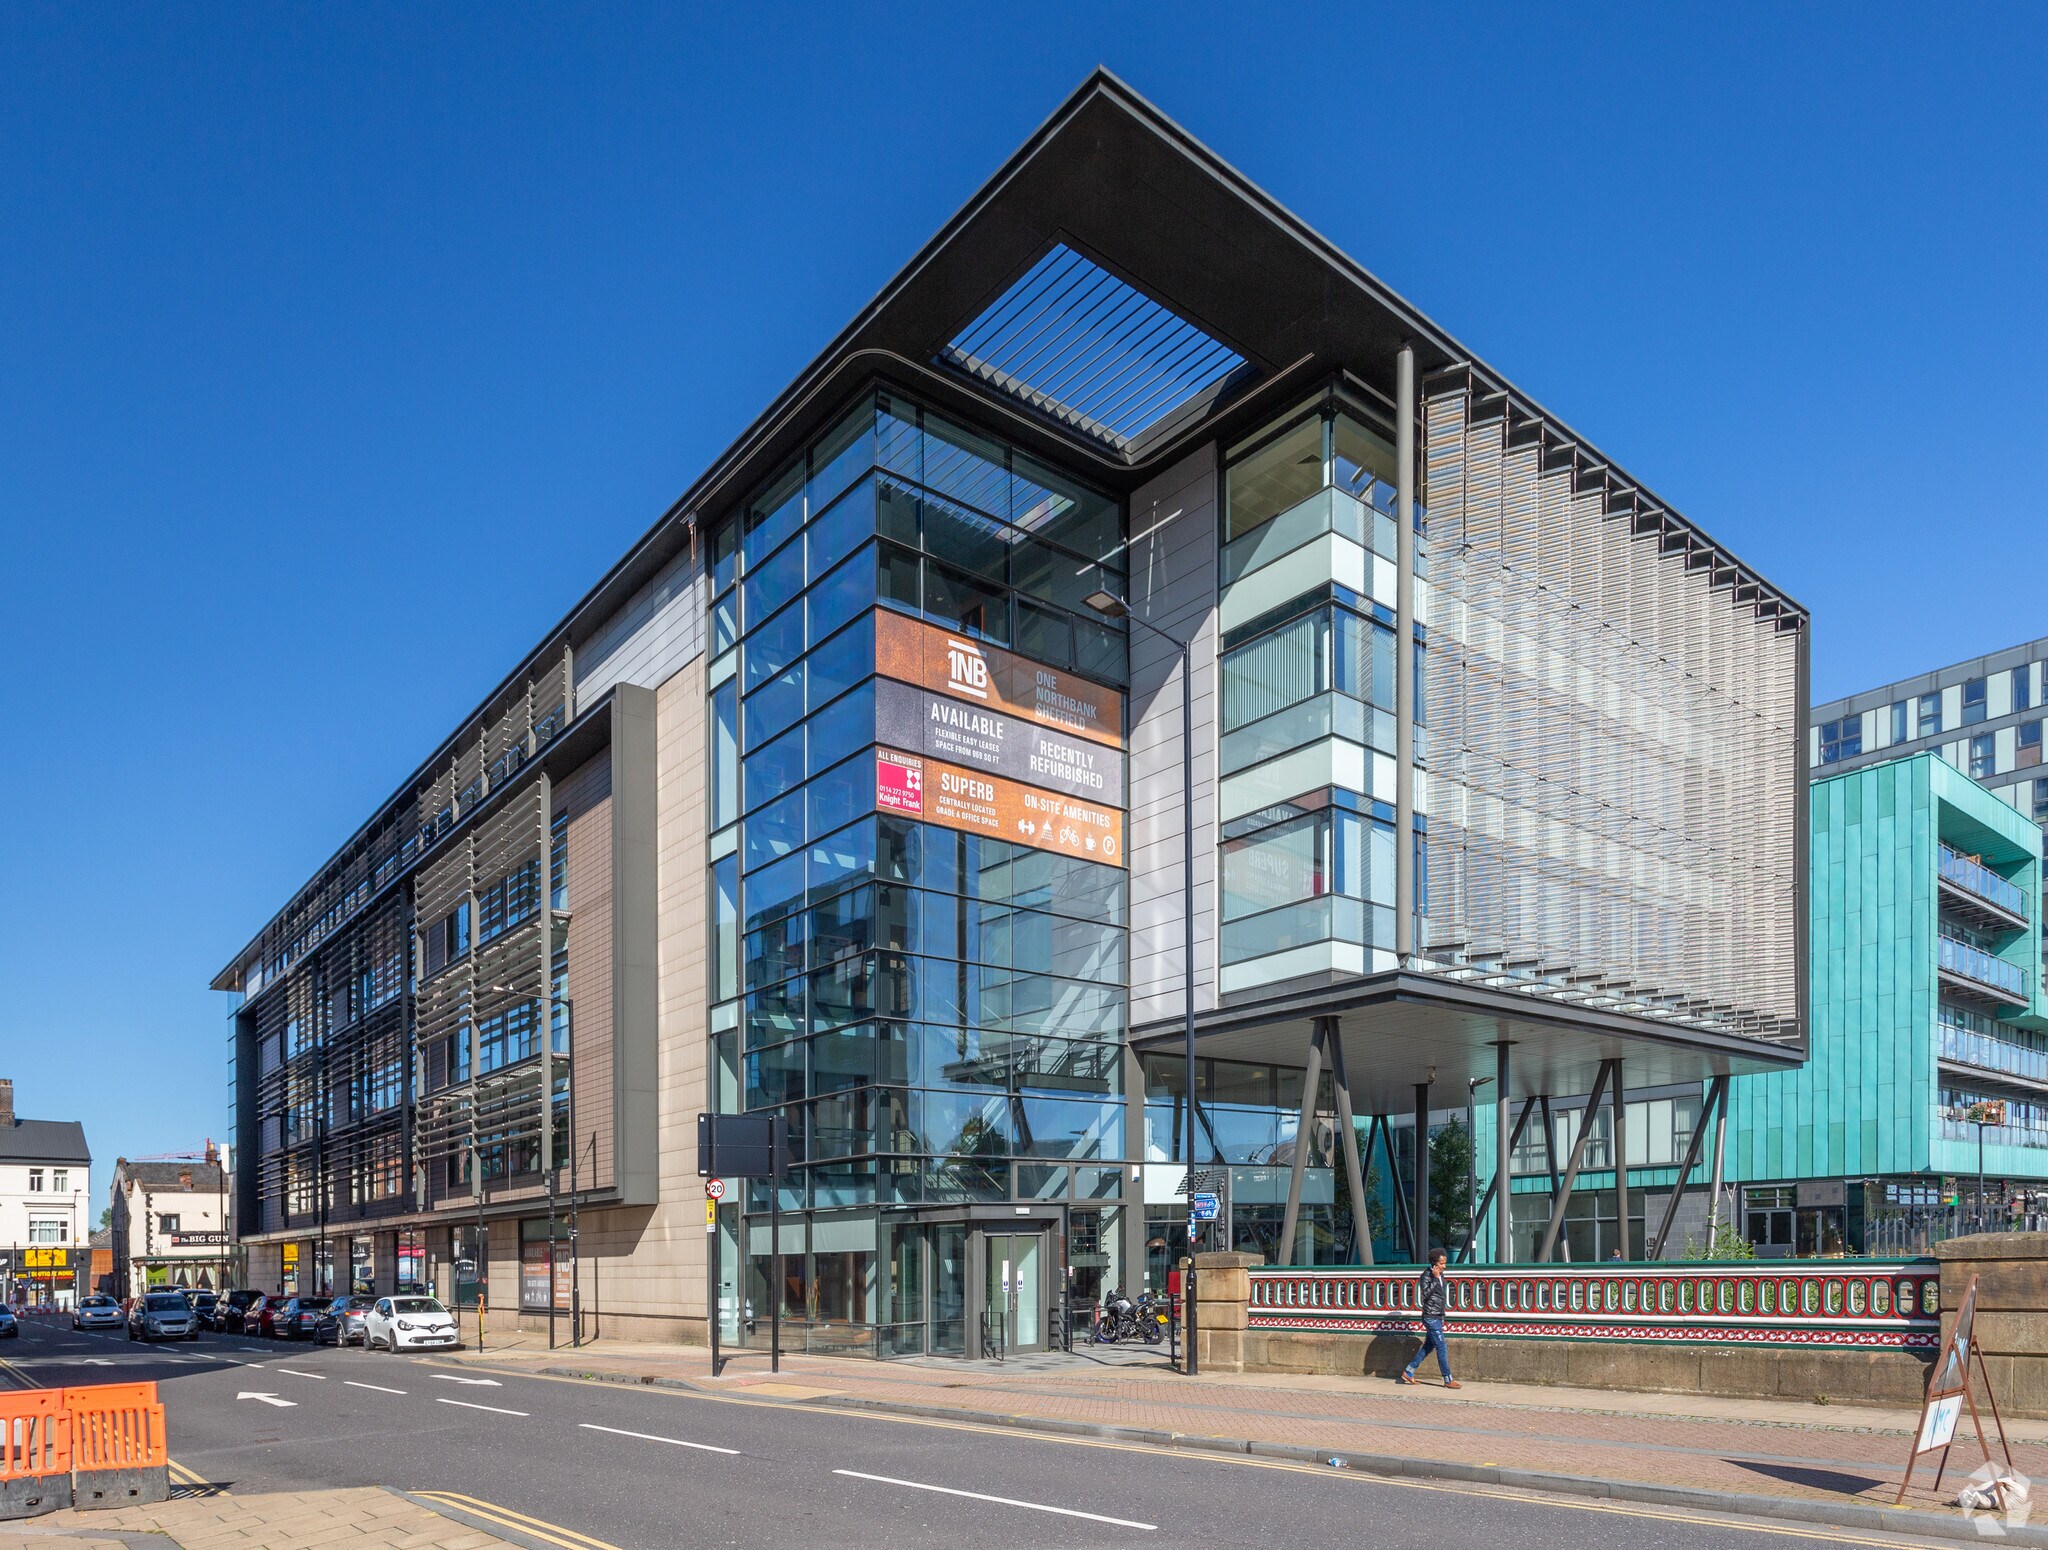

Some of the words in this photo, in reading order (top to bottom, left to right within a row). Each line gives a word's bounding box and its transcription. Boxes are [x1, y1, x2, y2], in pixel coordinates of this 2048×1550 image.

[948, 650, 987, 688] 1NB
[1036, 671, 1057, 690] ONE
[1036, 686, 1097, 720] NORTHBANK
[931, 702, 1004, 740] AVAILABLE
[1035, 702, 1086, 731] SHEFFIELD
[935, 727, 962, 742] FLEXIBLE
[962, 735, 978, 747] EASY
[978, 739, 1000, 753] LEASES
[935, 739, 955, 752] SPACE
[955, 745, 972, 757] FROM
[983, 753, 992, 763] SQ
[992, 755, 1000, 764] FT
[878, 750, 889, 760] ALL
[890, 753, 922, 769] ENQUIRIES
[1040, 740, 1094, 770] RECENTLY
[1030, 754, 1103, 789] REFURBISHED
[941, 772, 994, 802] SUPERB
[879, 792, 900, 806] Knight
[902, 797, 921, 810] Frank
[939, 795, 971, 810] CENTRALLY
[971, 803, 996, 816] LOCATED
[1024, 793, 1060, 816] ON-SITE
[1063, 804, 1110, 828] AMENITIES
[936, 805, 955, 818] GRADE
[955, 810, 961, 819] A
[961, 811, 981, 824] OFFICE
[981, 816, 999, 828] SPACE
[711, 1184, 723, 1193] 20
[189, 1235, 206, 1243] BIG
[208, 1235, 230, 1243] GUN
